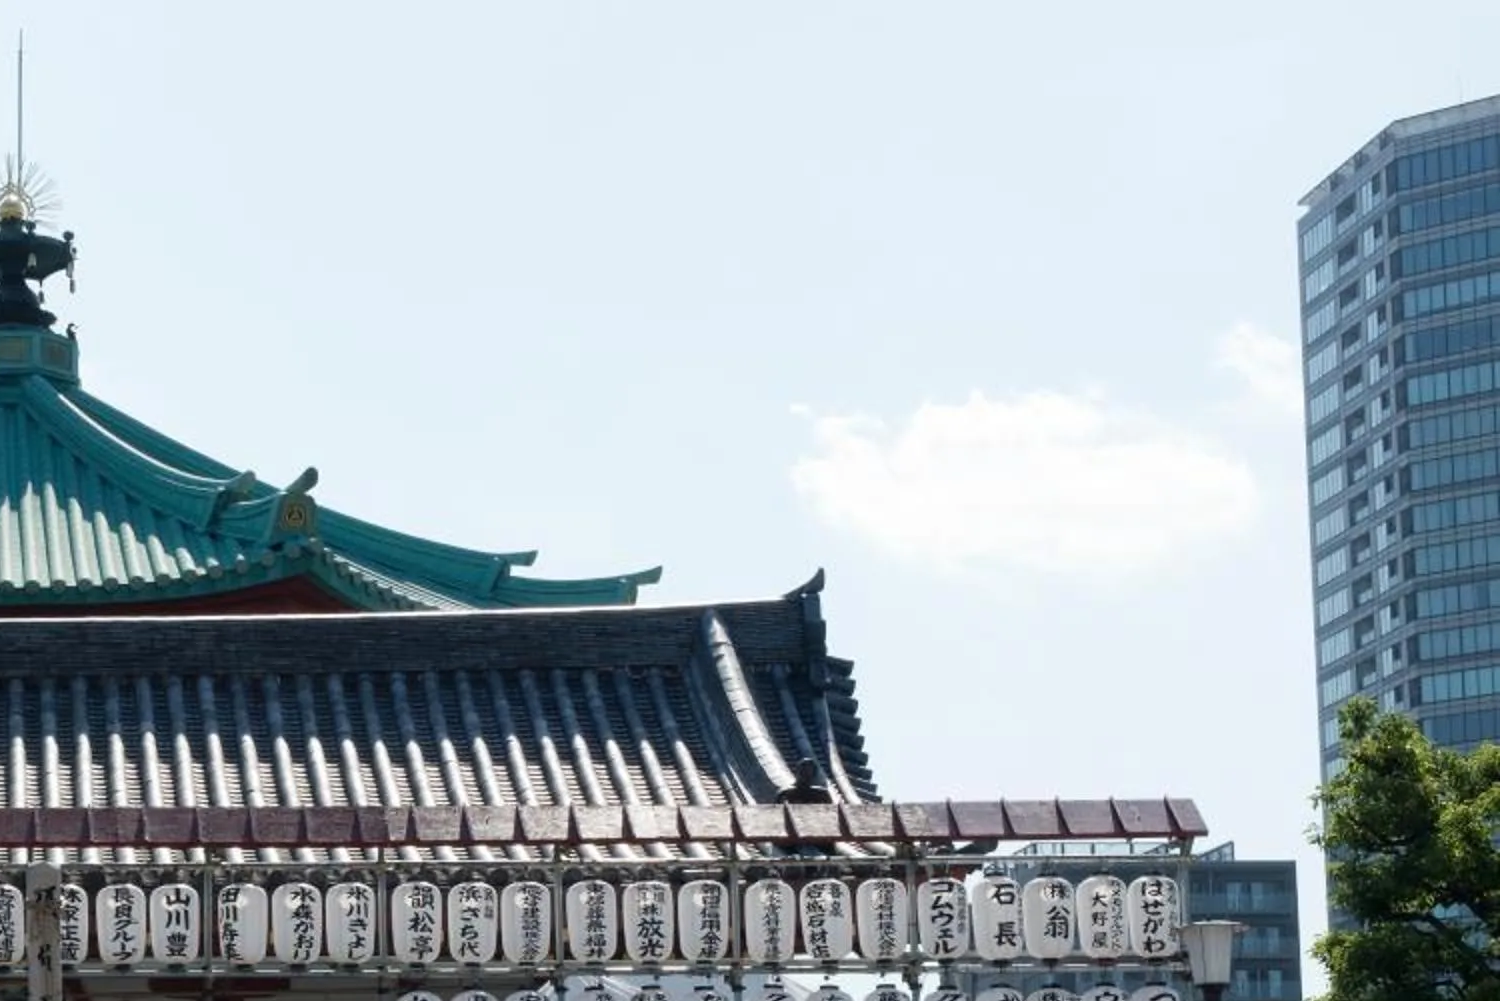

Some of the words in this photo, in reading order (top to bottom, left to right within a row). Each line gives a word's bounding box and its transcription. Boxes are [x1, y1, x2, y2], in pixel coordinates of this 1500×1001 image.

[165, 887, 191, 959] 山川豊
[289, 886, 316, 961] 水森かおり
[930, 880, 957, 956] コムウェル
[991, 883, 1018, 948] 石長
[1140, 879, 1167, 954] はせがわ
